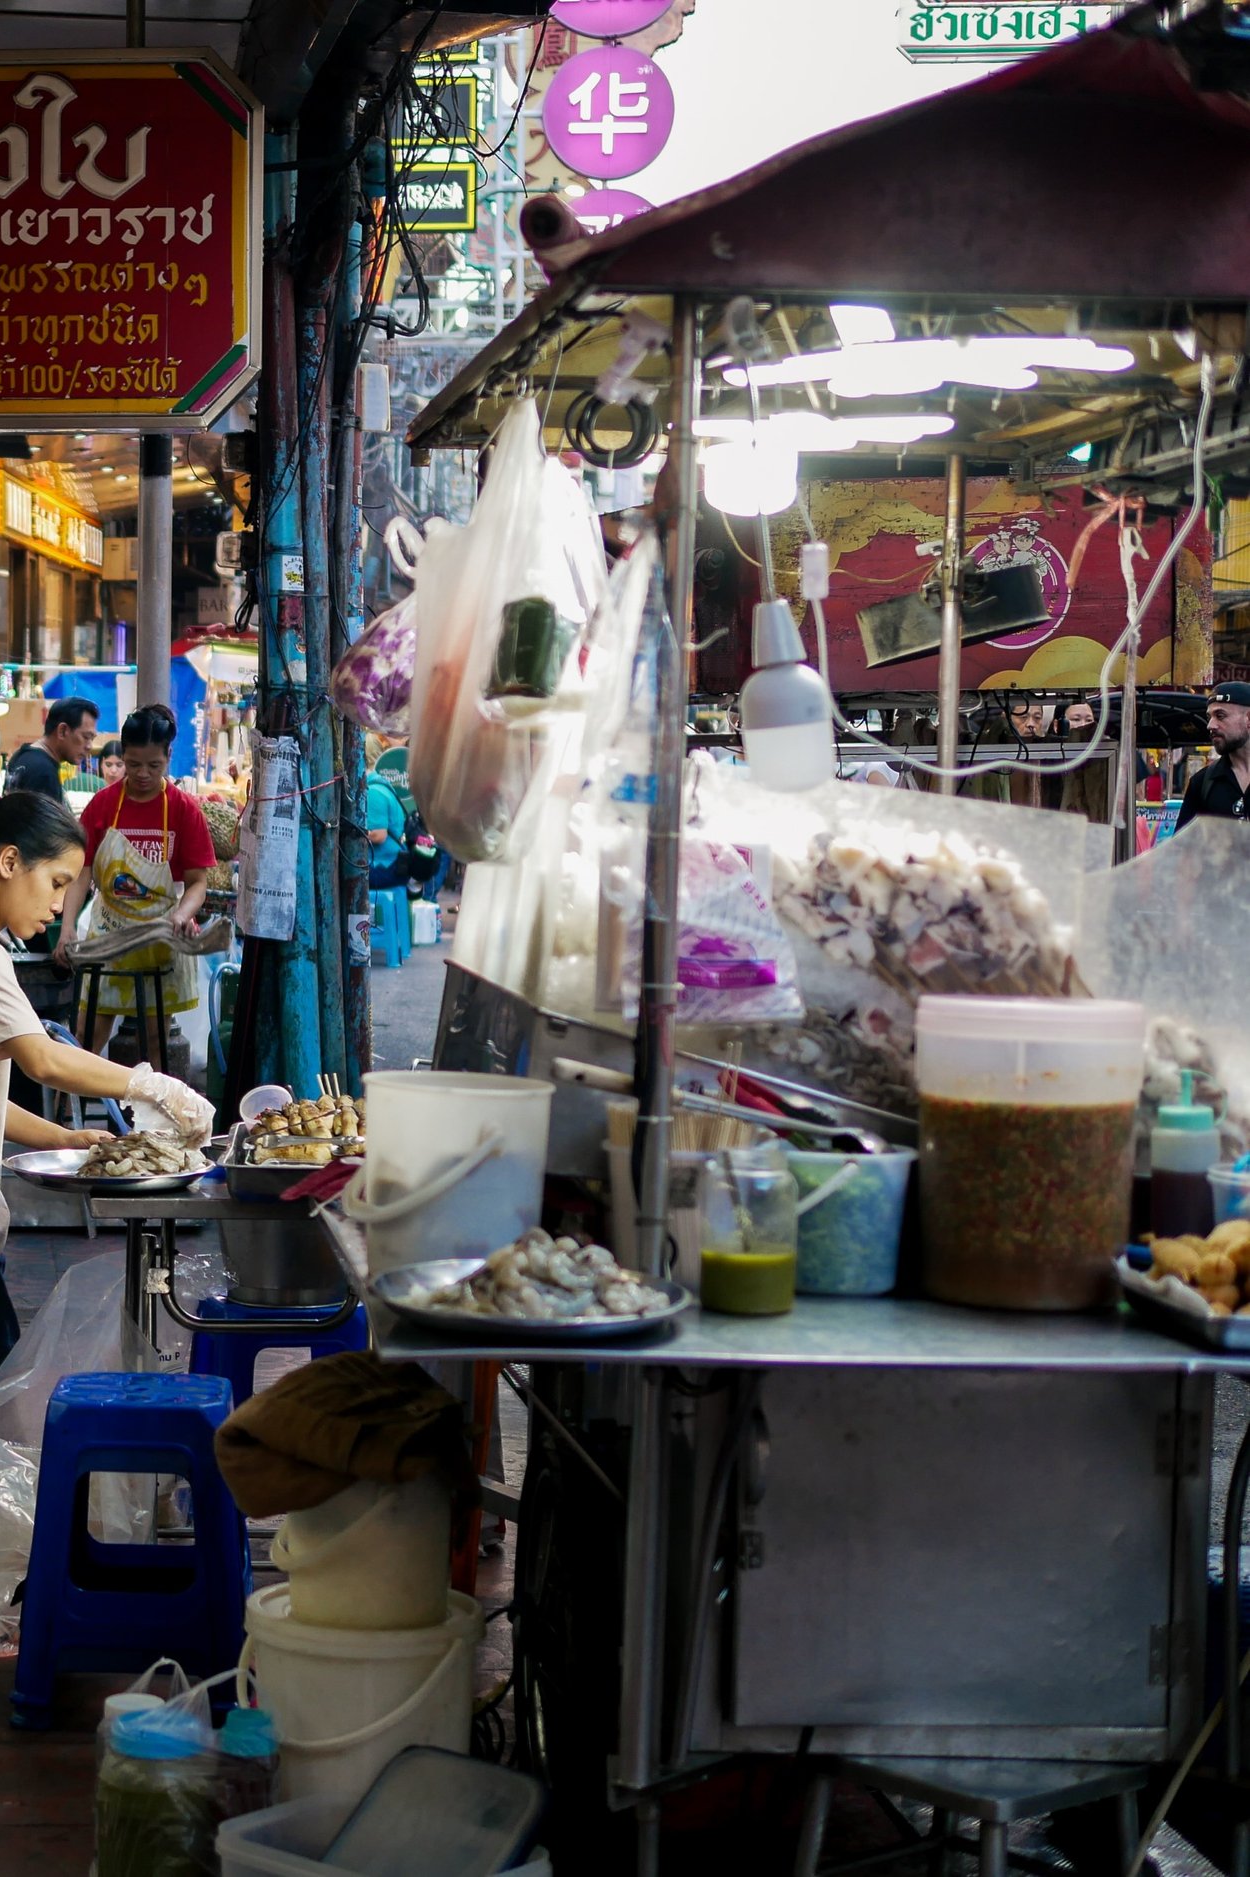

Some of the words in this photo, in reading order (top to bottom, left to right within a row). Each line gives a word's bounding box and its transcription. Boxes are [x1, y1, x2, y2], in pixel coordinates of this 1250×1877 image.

[568, 72, 650, 155] 华
[0, 192, 216, 246] เยาวราช
